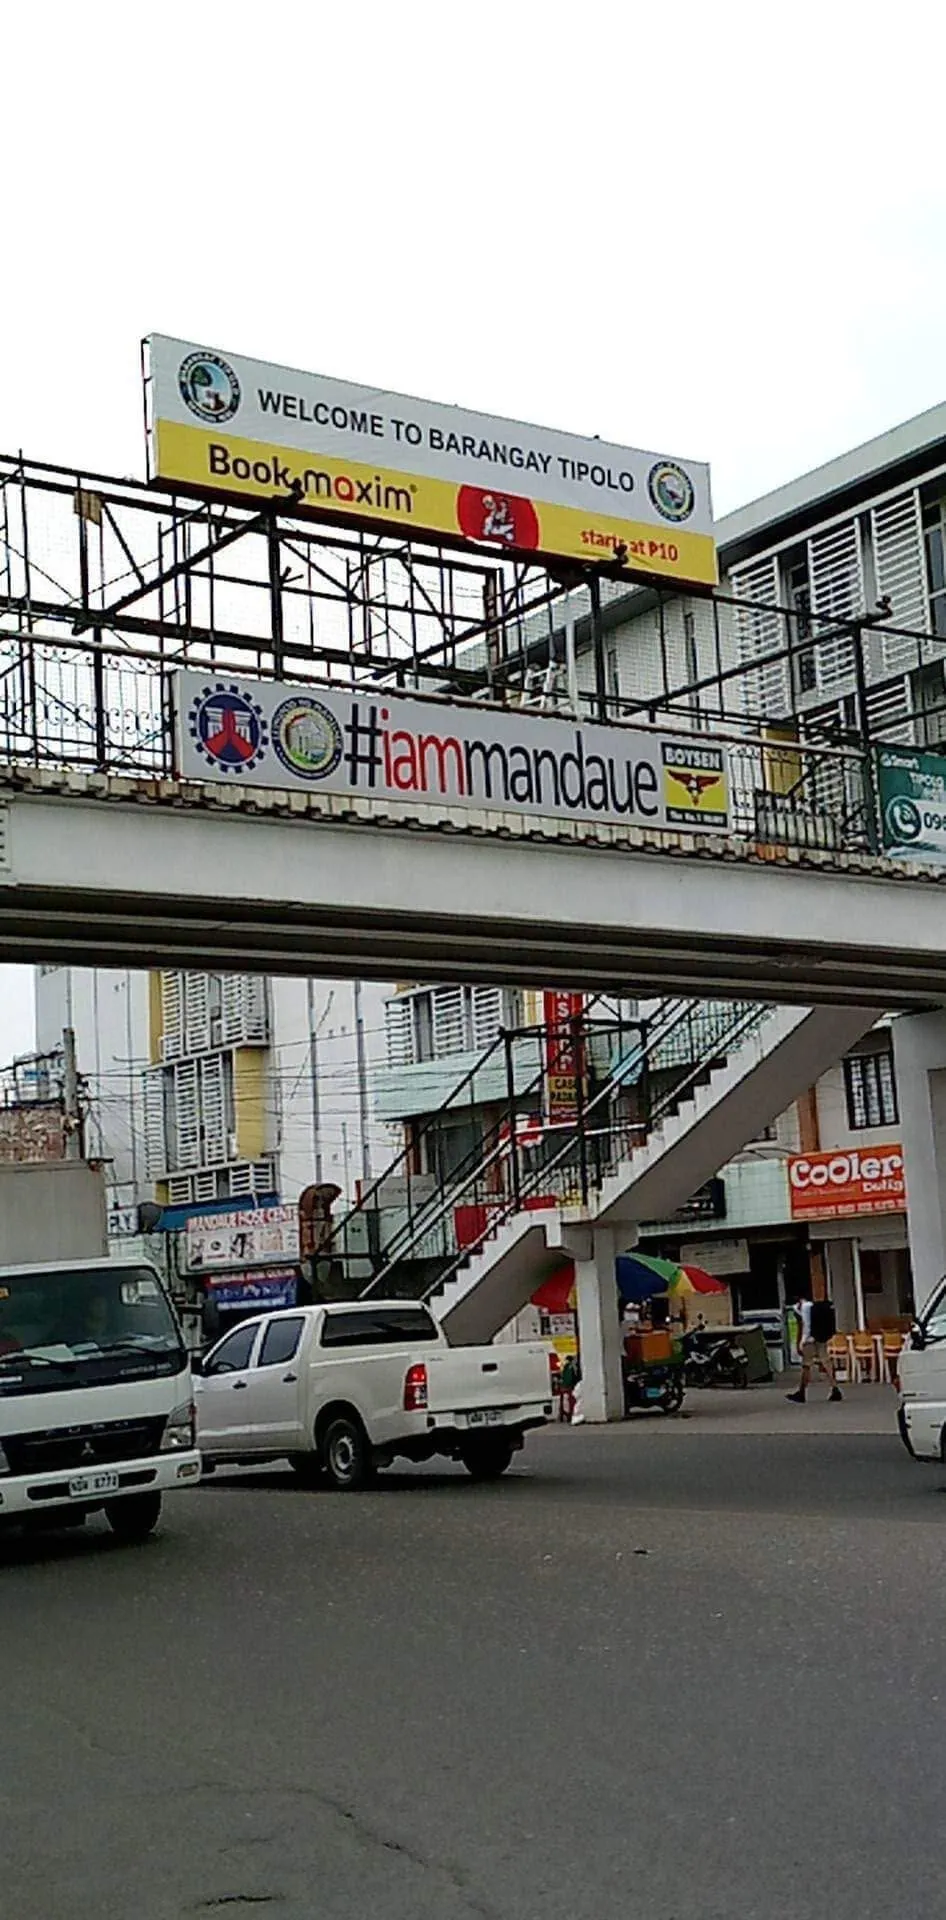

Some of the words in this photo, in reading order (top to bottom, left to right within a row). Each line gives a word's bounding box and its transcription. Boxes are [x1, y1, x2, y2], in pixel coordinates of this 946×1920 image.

[258, 389, 384, 437] WELCOME
[391, 420, 422, 445] TO
[429, 428, 552, 474] BARANGAY
[558, 457, 634, 492] TIPOLO
[208, 444, 291, 488] Book
[304, 470, 412, 513] maxim
[630, 541, 647, 554] at
[344, 703, 659, 817] #iammandaue
[665, 747, 721, 769] BOYSEN
[790, 1153, 902, 1188] Cooler
